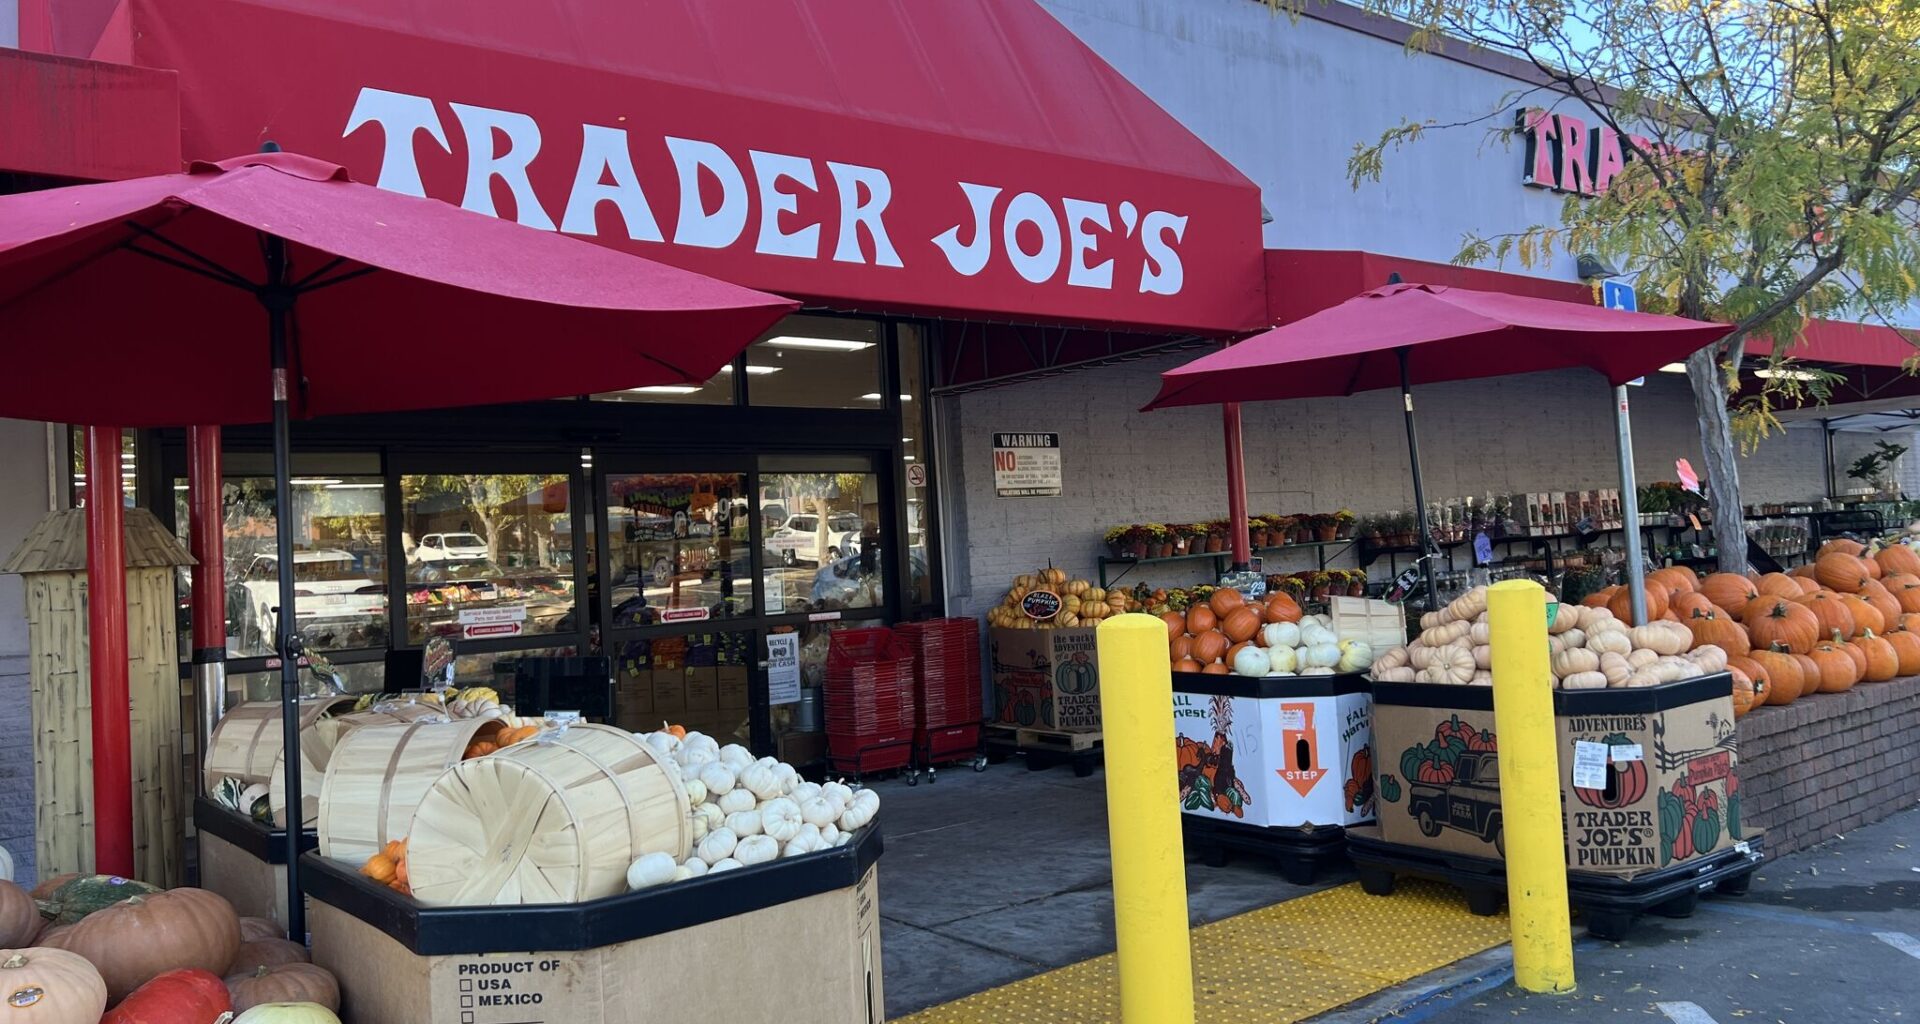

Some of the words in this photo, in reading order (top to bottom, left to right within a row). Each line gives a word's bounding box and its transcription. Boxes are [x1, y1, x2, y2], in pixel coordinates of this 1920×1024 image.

[343, 87, 904, 268] TRADER
[930, 181, 1189, 296] JOE'S
[1000, 434, 1051, 447] WARNING
[995, 451, 1016, 472] NO
[1027, 597, 1059, 606] PUMPKINS
[1054, 633, 1067, 643] the
[1058, 694, 1099, 705] TRADER
[1059, 705, 1094, 716] JOE'S
[1173, 708, 1207, 719] rvest
[1568, 716, 1647, 732] ADVENTURES
[1286, 771, 1319, 780] STEP
[1574, 811, 1653, 828] TRADER
[1577, 847, 1656, 866] PUMPKIN
[458, 961, 534, 976] PRODUCT
[539, 960, 560, 972] OF
[478, 978, 512, 991] USA
[478, 992, 543, 1007] MEXICO
